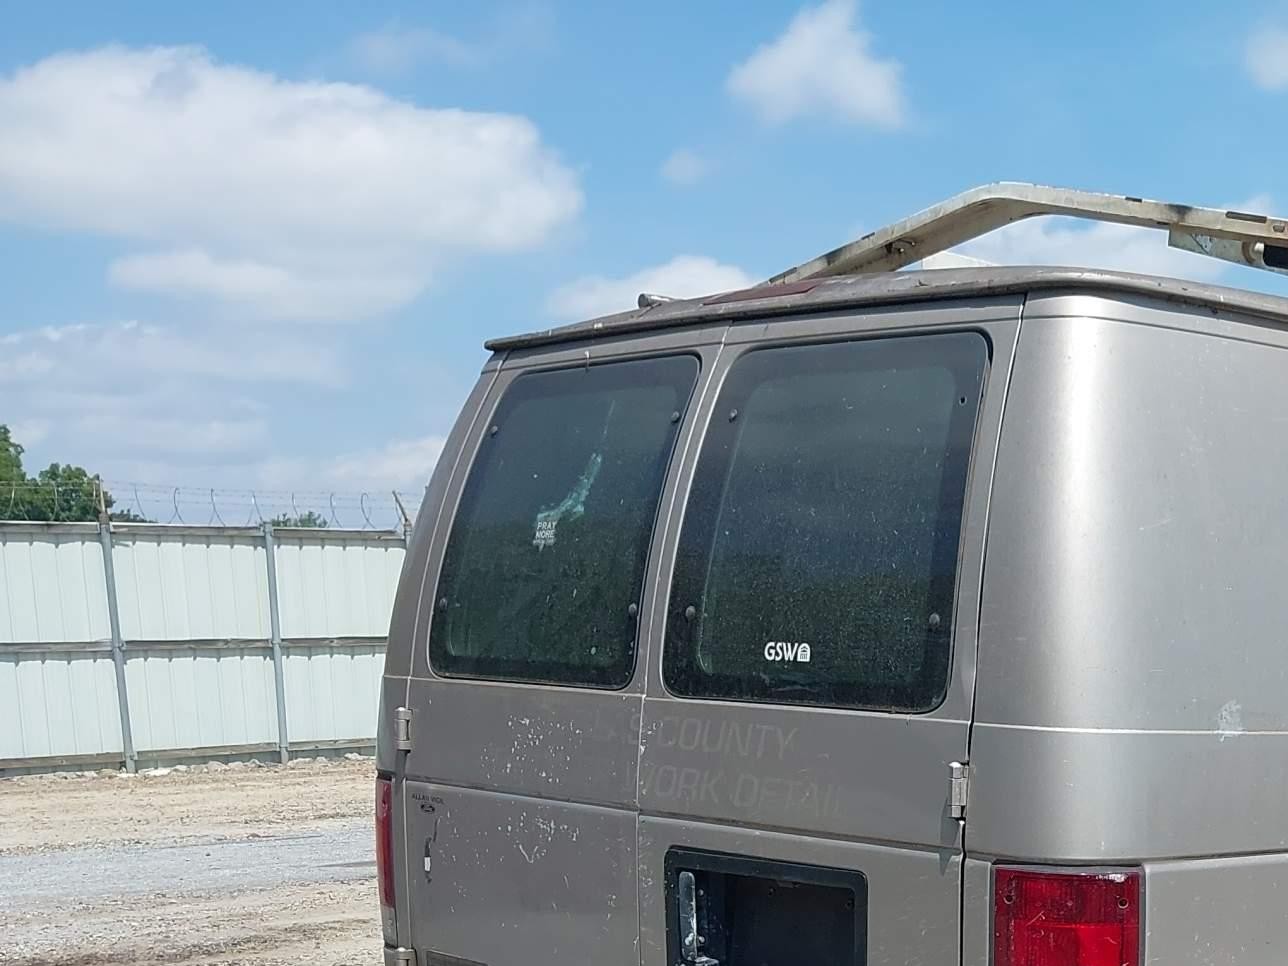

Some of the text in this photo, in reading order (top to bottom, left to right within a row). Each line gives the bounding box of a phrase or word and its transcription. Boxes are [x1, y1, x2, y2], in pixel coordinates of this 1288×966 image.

[537, 521, 557, 530] PRAY
[535, 530, 556, 540] MORE
[764, 641, 798, 662] GSW
[656, 715, 799, 760] COUNTY
